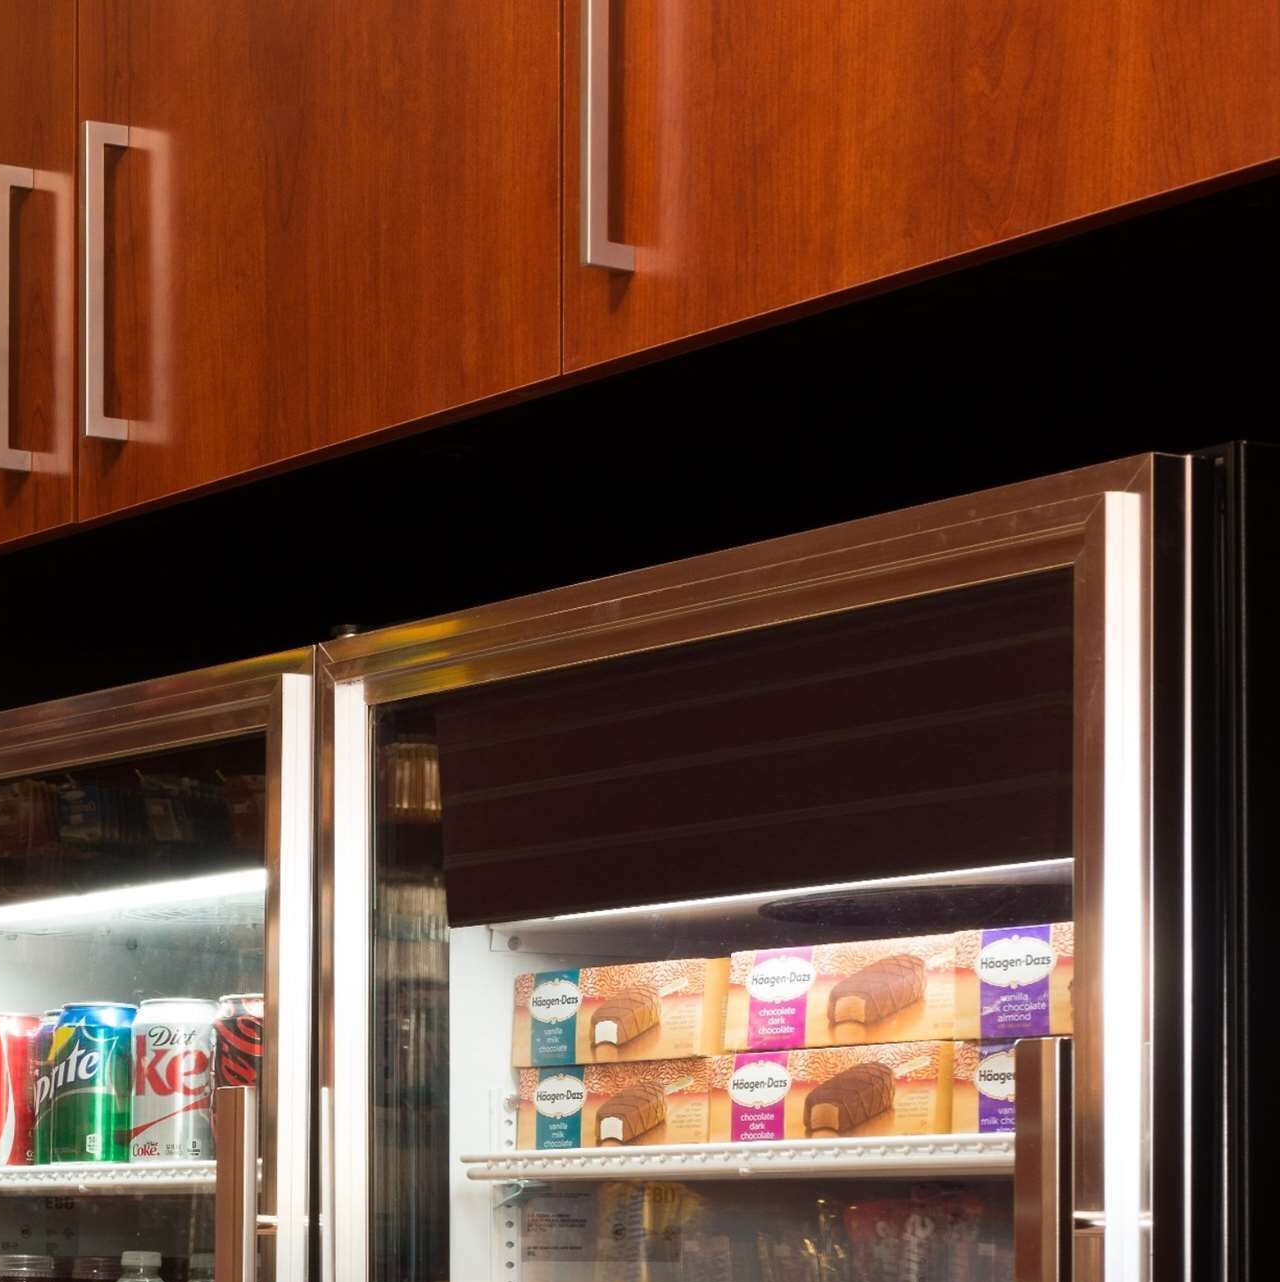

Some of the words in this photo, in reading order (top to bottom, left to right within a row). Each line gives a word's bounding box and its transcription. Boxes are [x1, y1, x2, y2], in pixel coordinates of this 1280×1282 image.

[980, 953, 1052, 972] Häagen-Dazs
[751, 971, 812, 987] Häagen-Dazs
[531, 994, 579, 1009] Häagen-Dazs
[758, 1005, 796, 1017] chocolate
[767, 1015, 786, 1026] dark
[757, 1024, 795, 1035] chocolate
[33, 1038, 102, 1118] prite
[732, 1074, 788, 1093] Häagen-Dazs
[536, 1089, 584, 1104] Häagen-Dazs
[740, 1112, 775, 1122] chocolate
[749, 1121, 766, 1131] dark
